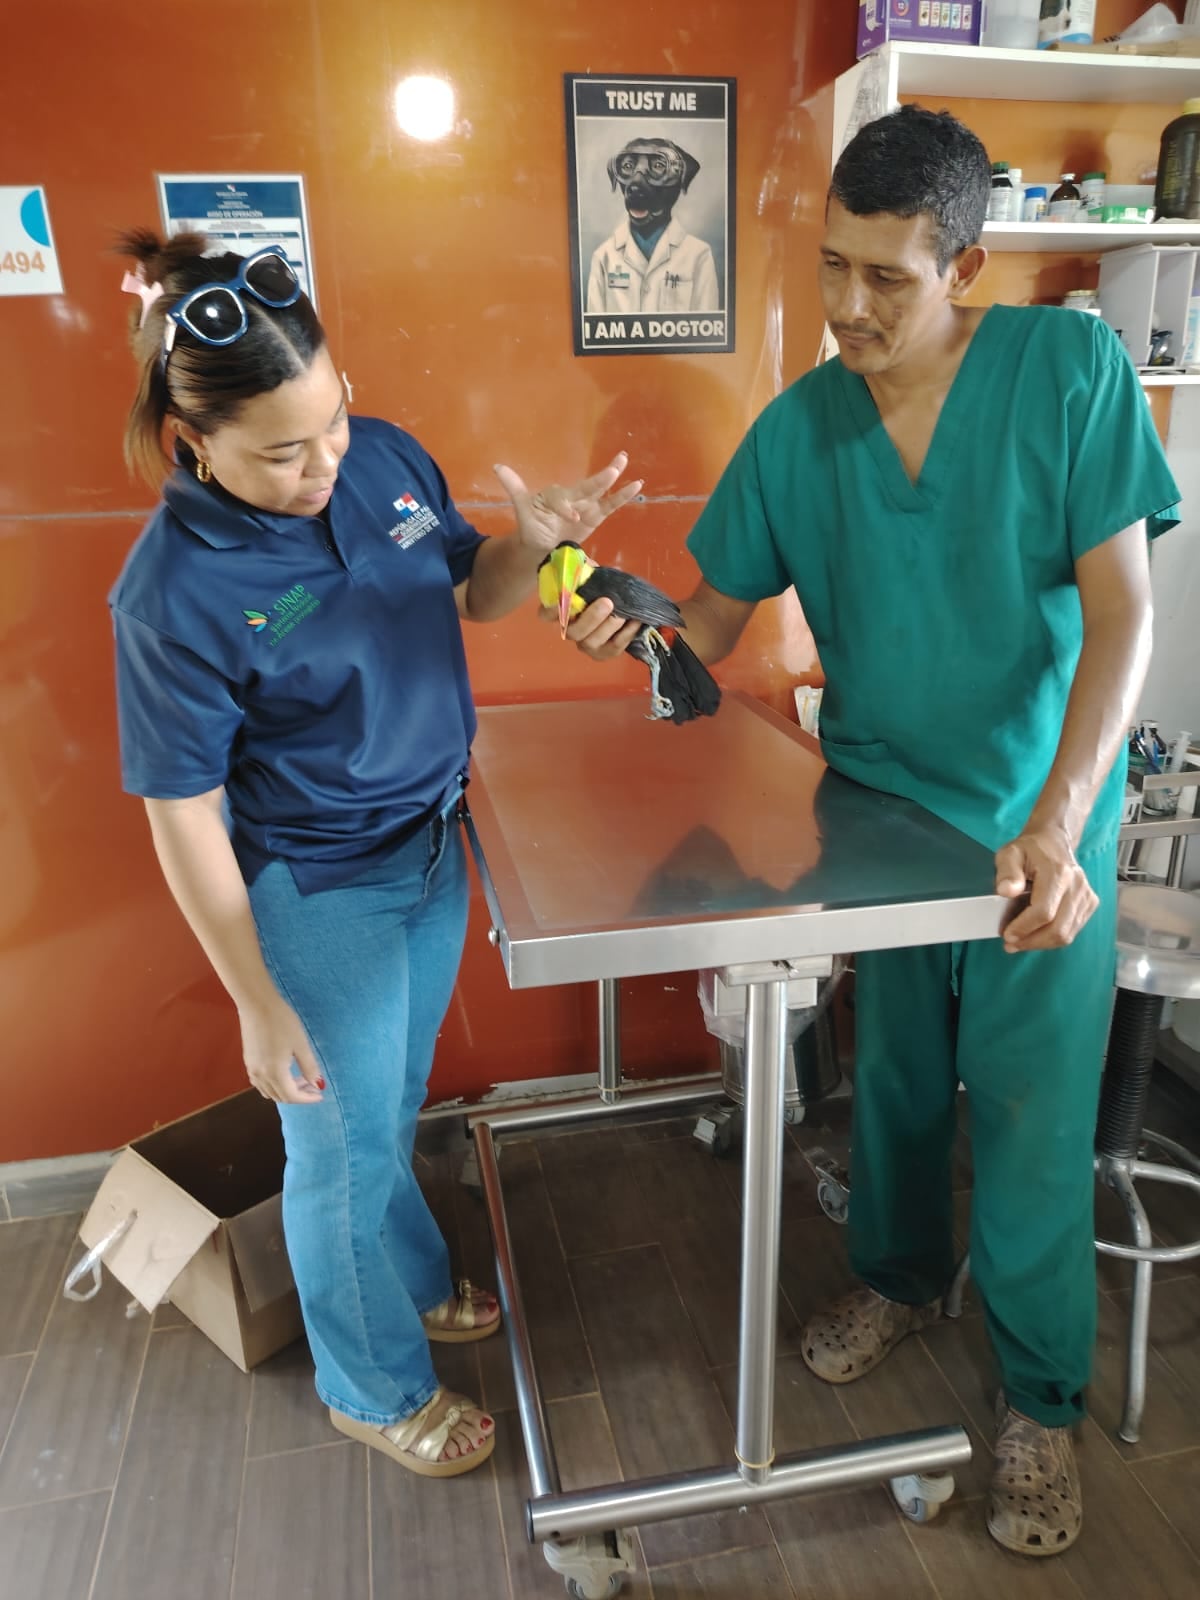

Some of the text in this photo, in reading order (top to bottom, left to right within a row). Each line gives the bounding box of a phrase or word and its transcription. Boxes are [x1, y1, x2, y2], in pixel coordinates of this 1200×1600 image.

[606, 91, 697, 111] TRUST ME
[0, 250, 45, 273] 494
[584, 320, 724, 339] I AM A DOGTOR
[273, 584, 305, 615] SINAP
